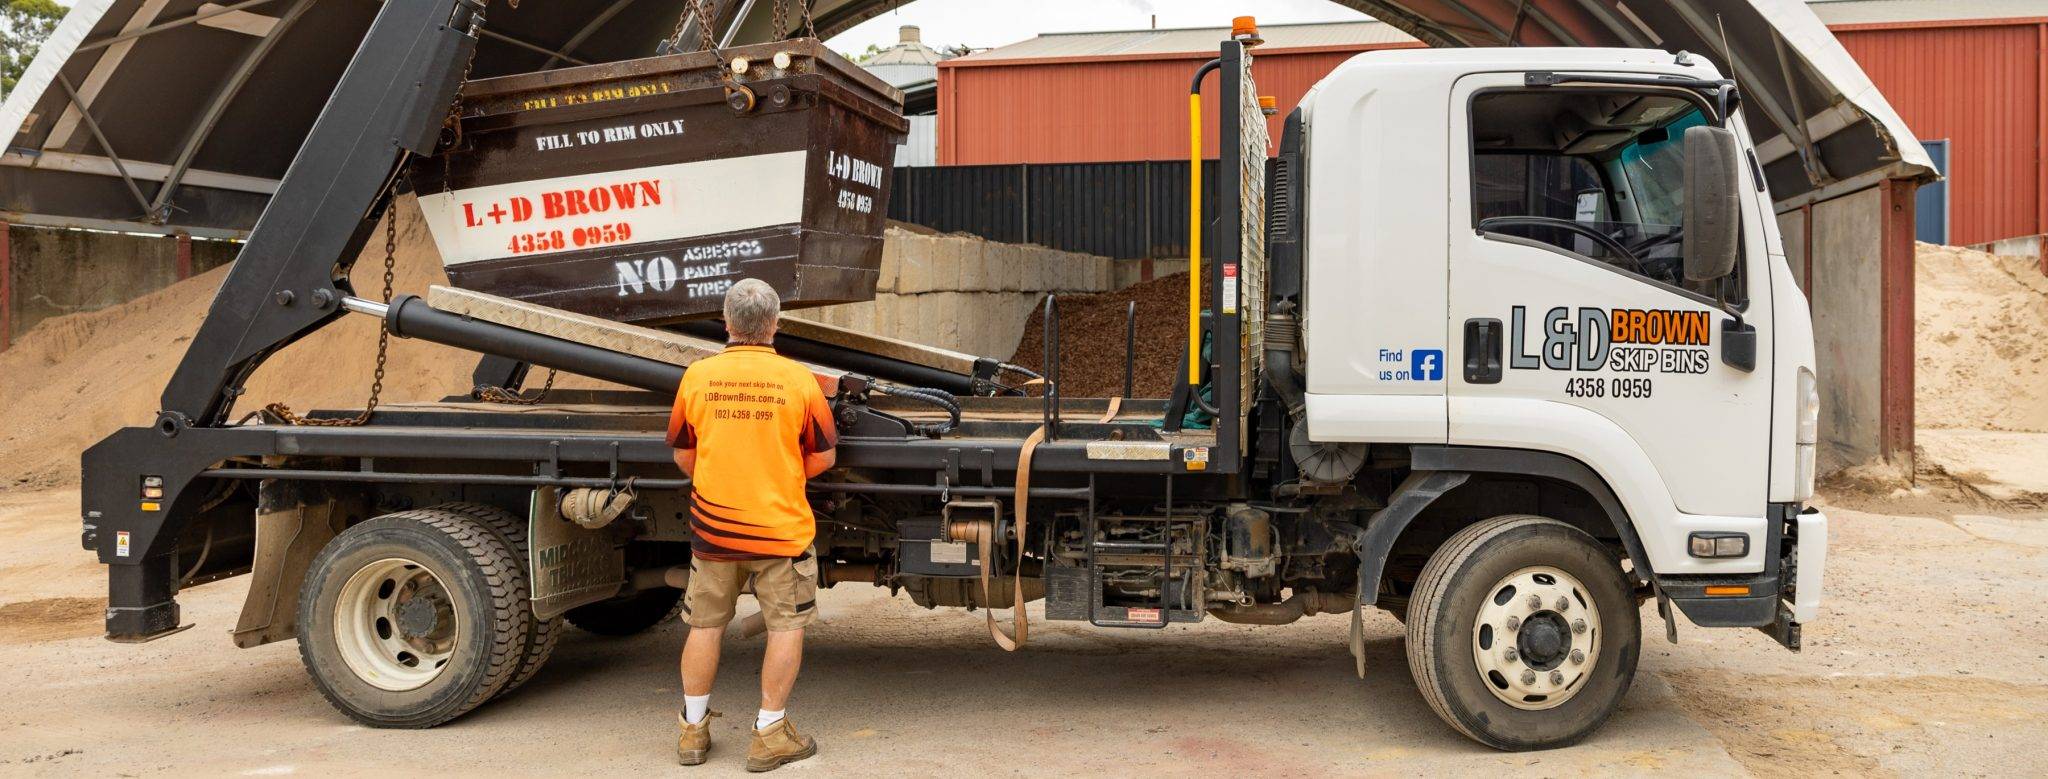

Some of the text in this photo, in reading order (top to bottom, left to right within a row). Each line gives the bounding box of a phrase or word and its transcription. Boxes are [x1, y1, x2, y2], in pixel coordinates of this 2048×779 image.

[536, 119, 684, 151] FILL TO RIM ONLY
[829, 150, 883, 190] L+D BROWN
[462, 180, 661, 228] L+D BROWN
[838, 189, 856, 210] 4358
[507, 222, 632, 254] 4358 0959
[683, 240, 763, 262] ASBESTOS
[615, 256, 677, 296] NO
[684, 262, 730, 280] PAINT
[686, 279, 733, 298] TYRES
[1510, 305, 1710, 371] L&D BROWN
[1379, 349, 1403, 361] Find
[1610, 347, 1709, 374] SKIP BINS
[709, 380, 722, 388] Book
[724, 381, 737, 389] your
[753, 381, 765, 389] skip
[1379, 371, 1393, 381] us
[1395, 371, 1410, 381] on
[1565, 378, 1652, 398] 4358 0959
[704, 392, 786, 406] LDBrownBins.com.au
[715, 409, 730, 420] (02)
[731, 410, 751, 420] 4358
